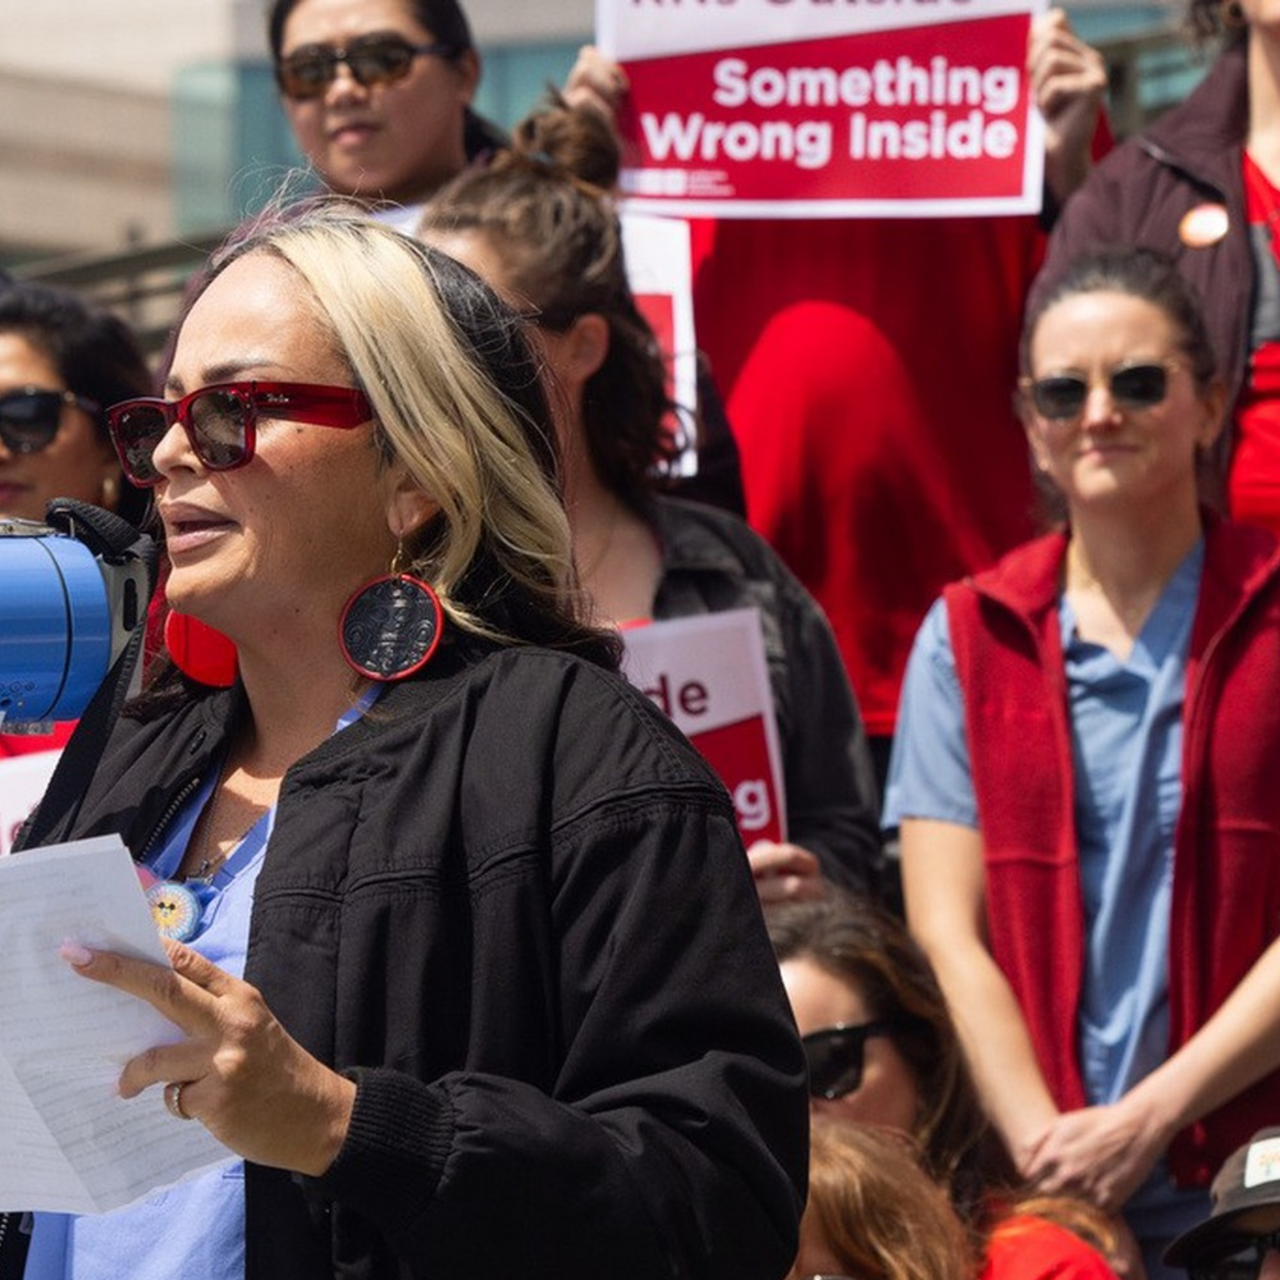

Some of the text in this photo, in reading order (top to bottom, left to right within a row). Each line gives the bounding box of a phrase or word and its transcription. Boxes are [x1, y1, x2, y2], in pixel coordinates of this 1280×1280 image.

[711, 56, 1020, 115] Something
[641, 110, 1019, 169] Wrong Inside
